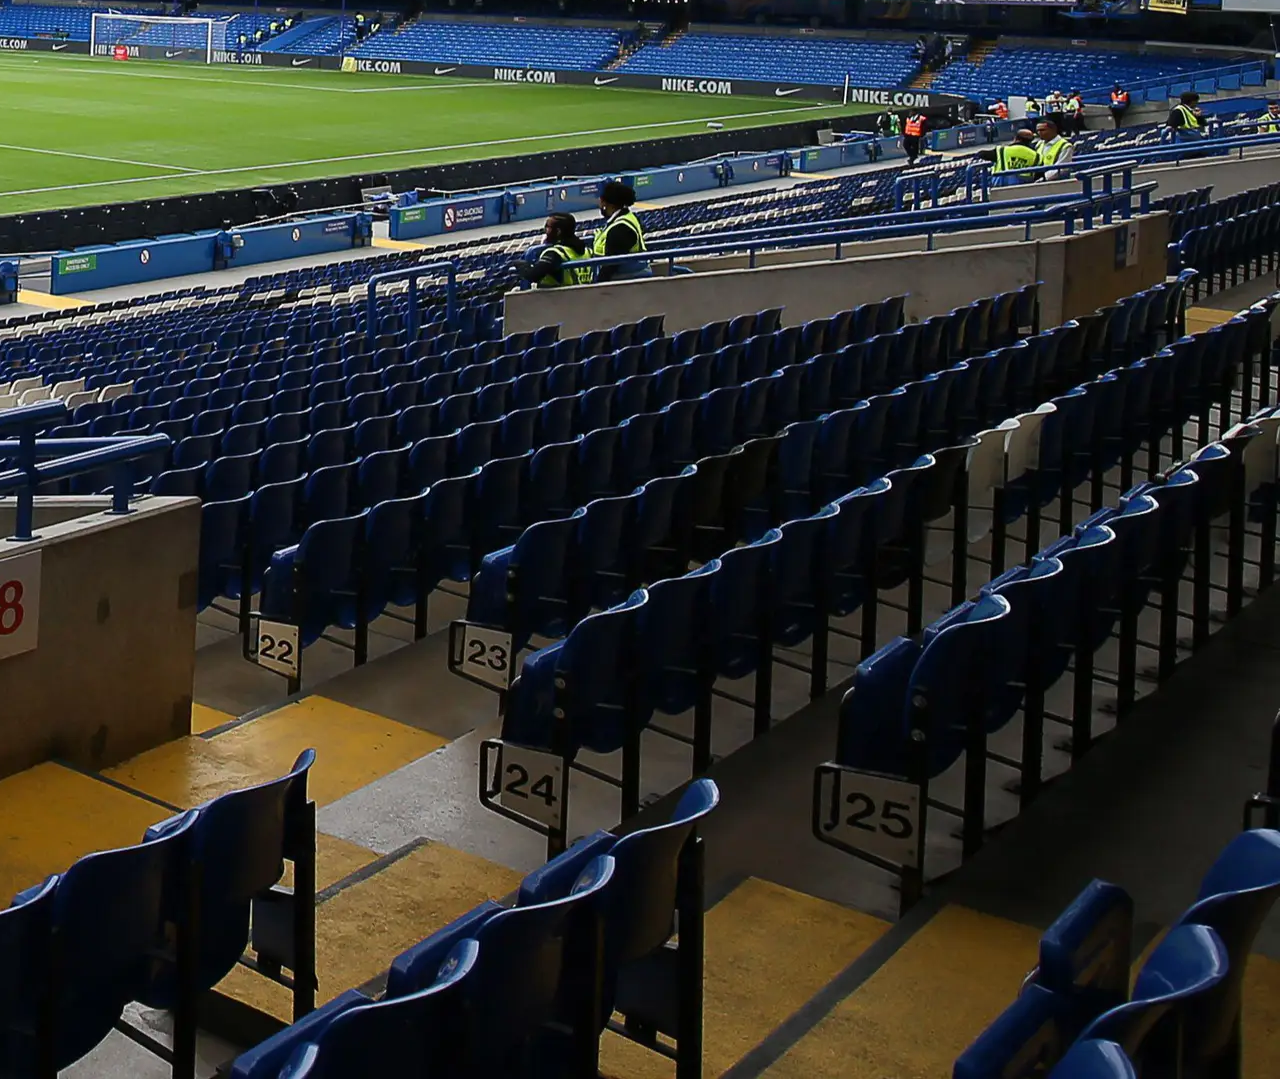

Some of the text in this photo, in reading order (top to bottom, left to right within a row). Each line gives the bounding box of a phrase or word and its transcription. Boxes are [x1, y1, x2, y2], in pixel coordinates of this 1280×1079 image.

[493, 68, 555, 83] NIKE.COM
[662, 78, 732, 94] NIKE.COM
[852, 89, 929, 107] NIKE.COM
[259, 634, 294, 666] 22
[467, 639, 508, 672] 23
[505, 763, 556, 807] 24
[846, 792, 913, 840] 25
